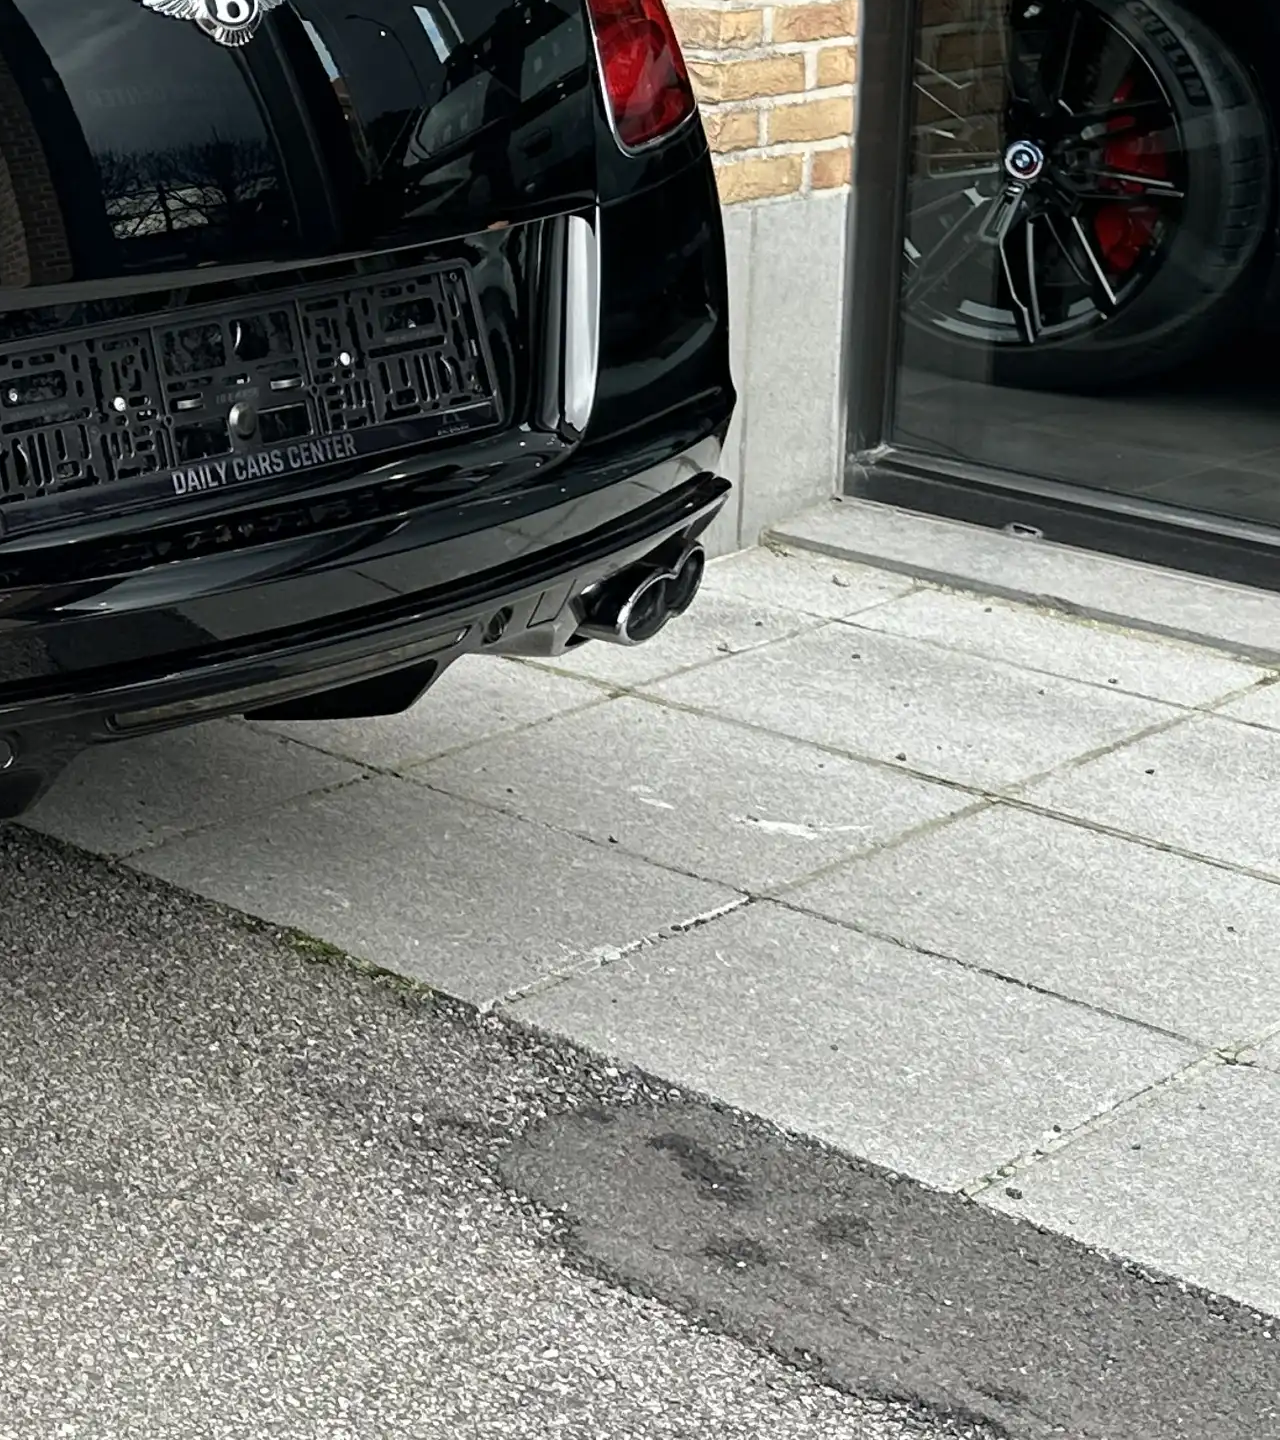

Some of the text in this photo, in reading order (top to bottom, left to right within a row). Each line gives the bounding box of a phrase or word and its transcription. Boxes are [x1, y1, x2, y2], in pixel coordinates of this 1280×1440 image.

[171, 433, 358, 495] DAILY CARS CENTER
